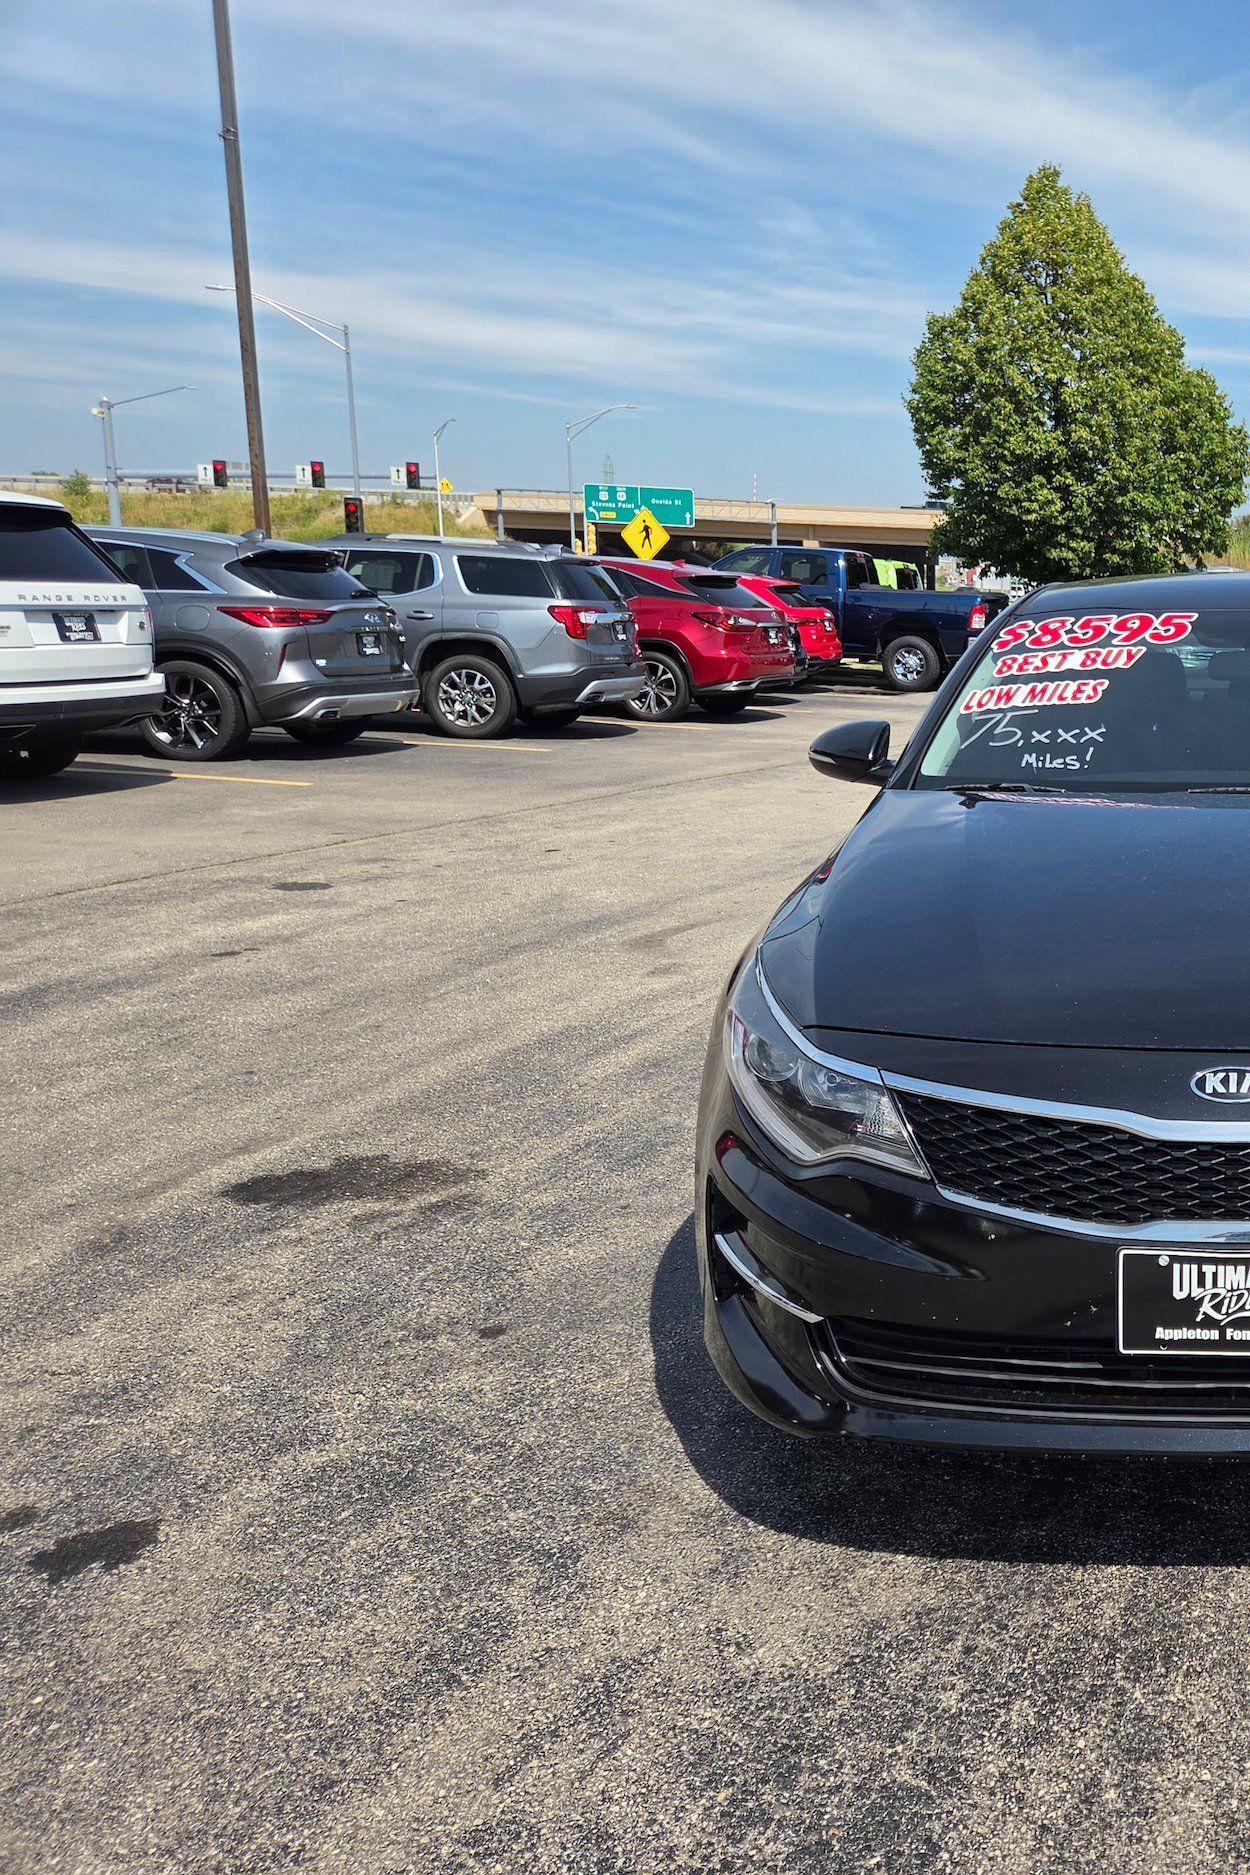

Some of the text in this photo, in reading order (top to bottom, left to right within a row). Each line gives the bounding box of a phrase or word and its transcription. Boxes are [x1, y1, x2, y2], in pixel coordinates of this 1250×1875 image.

[17, 594, 74, 602] RANGE
[992, 612, 1198, 652] $8595
[993, 647, 1145, 677] BEST BUY
[961, 680, 1108, 713] LOW MILES
[1155, 1327, 1220, 1341] Appleton
